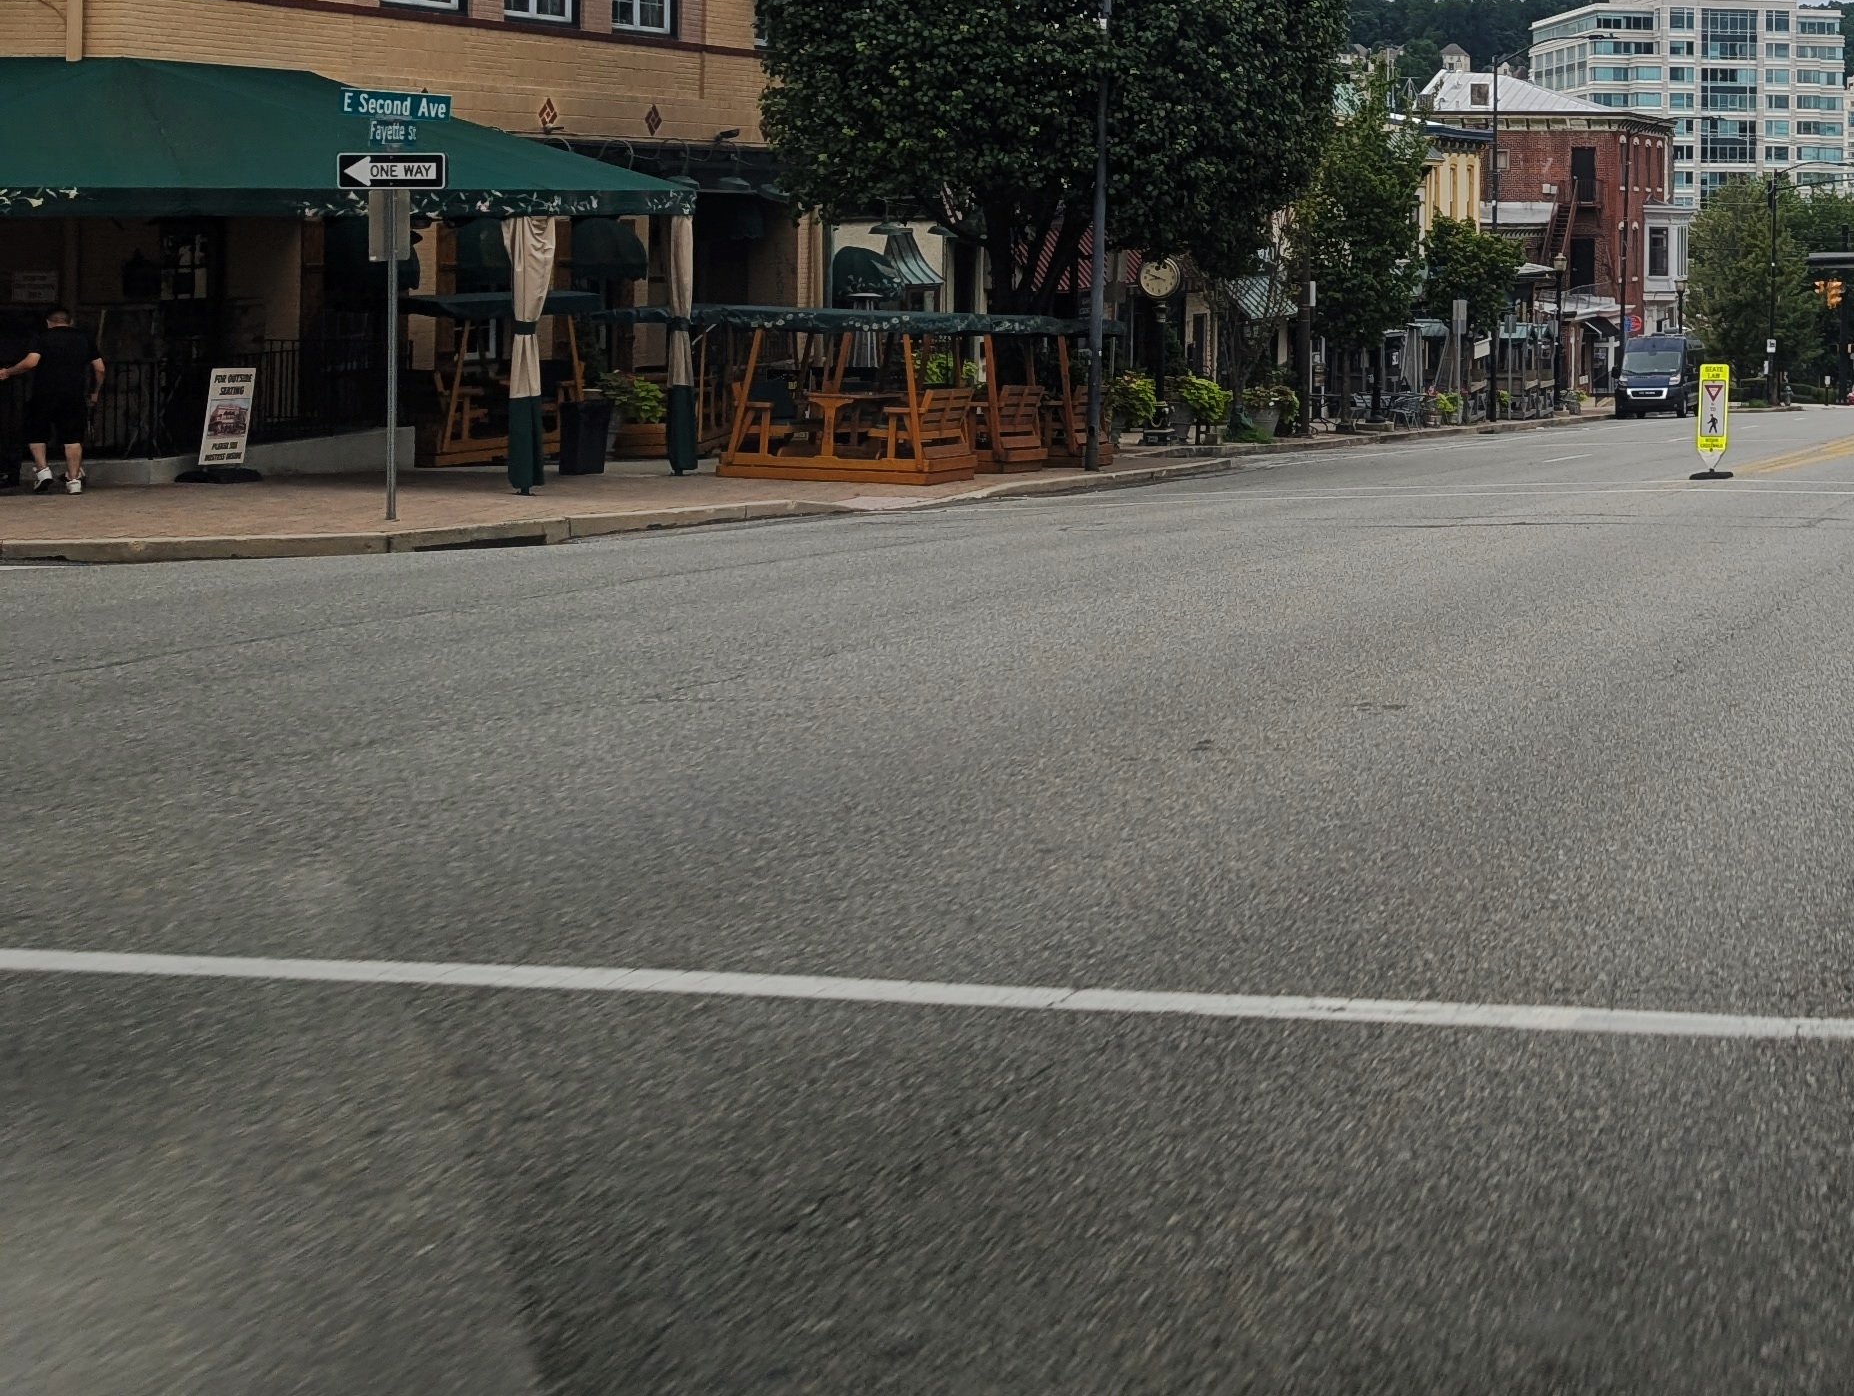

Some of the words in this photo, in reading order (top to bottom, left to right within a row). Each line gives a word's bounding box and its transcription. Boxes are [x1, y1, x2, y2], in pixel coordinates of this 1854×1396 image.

[343, 92, 354, 112] E
[358, 93, 412, 116] Second
[417, 97, 447, 118] Ave
[369, 120, 406, 145] Fayette
[369, 164, 398, 178] ONE
[403, 164, 432, 178] WAY
